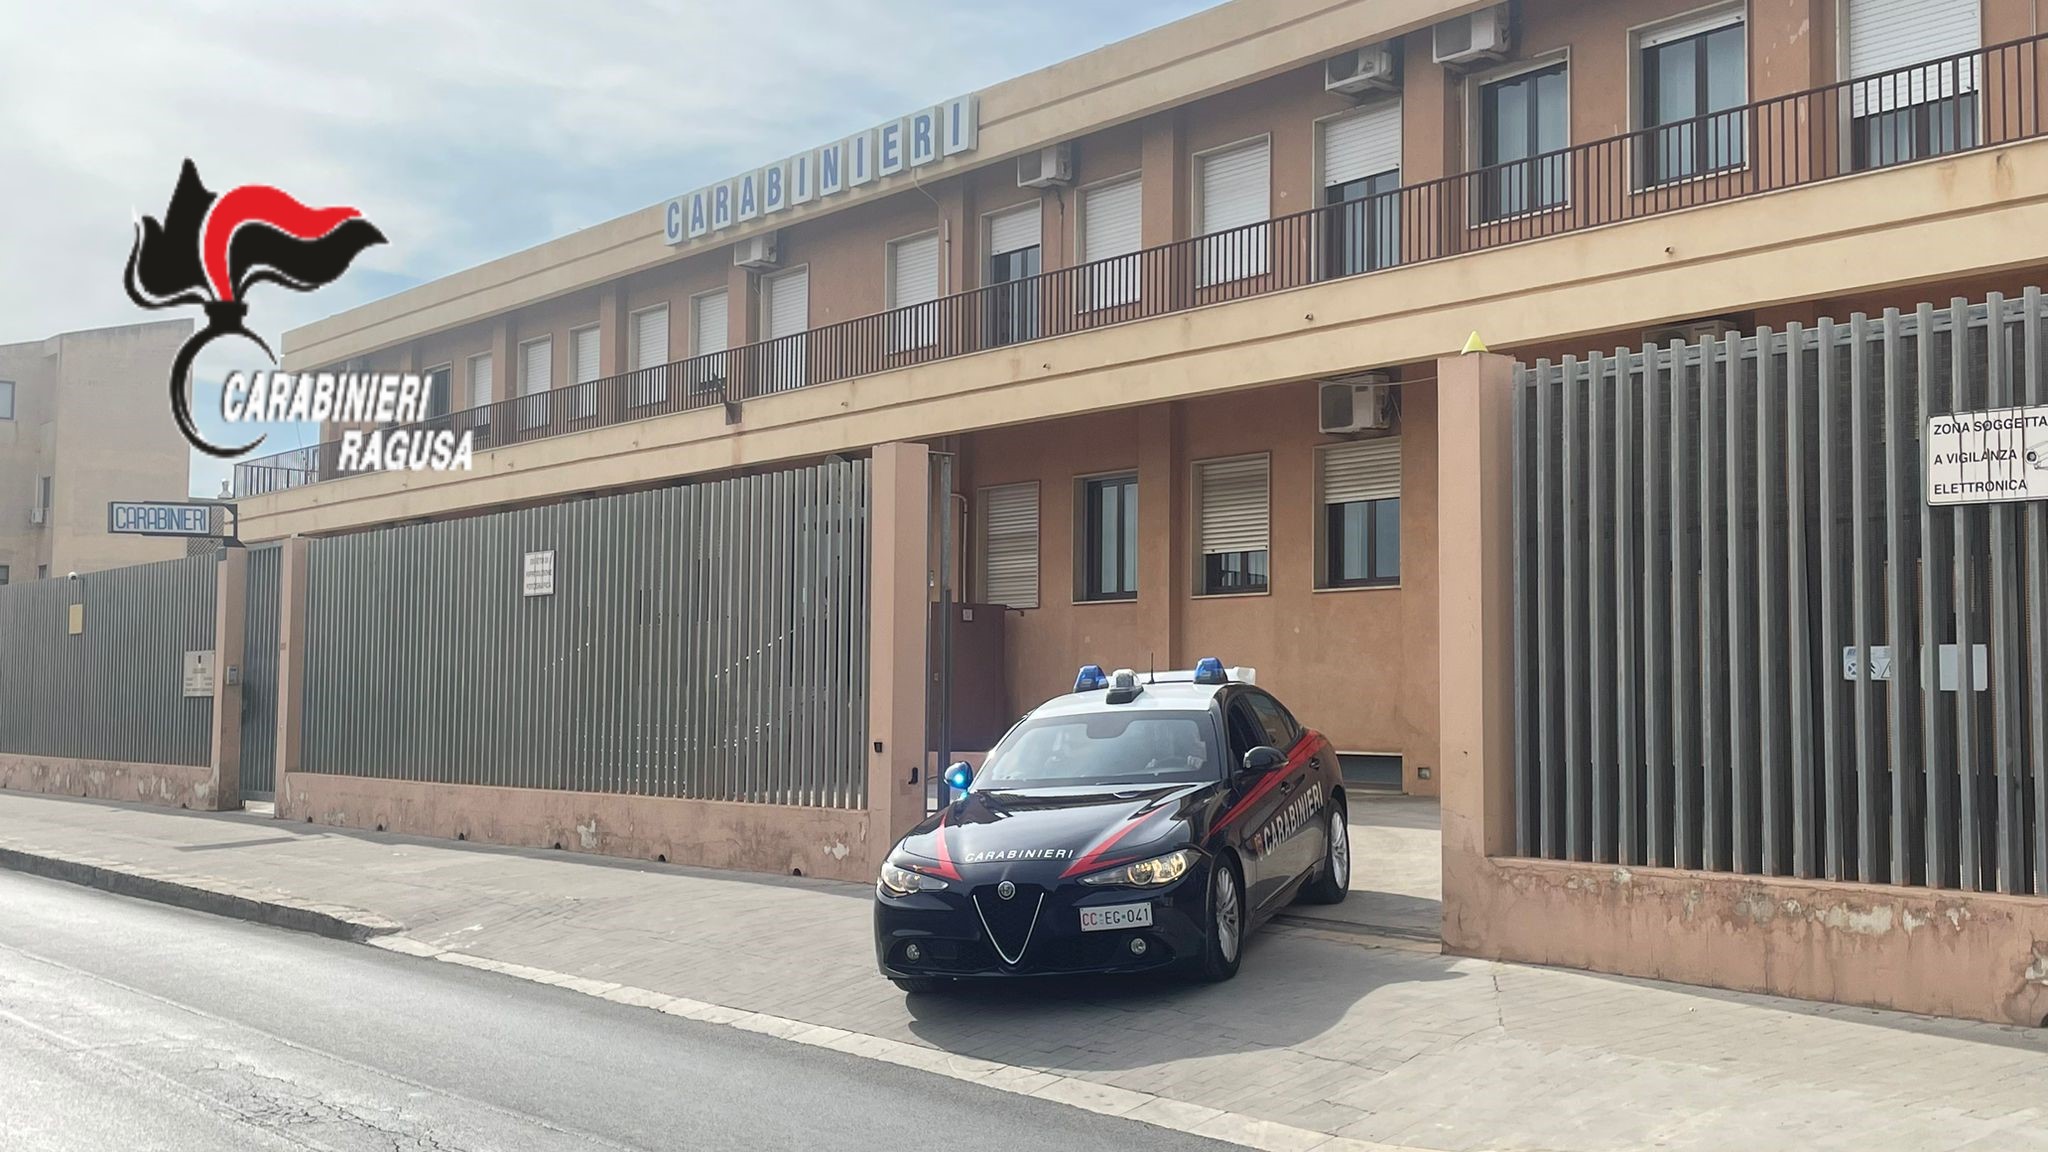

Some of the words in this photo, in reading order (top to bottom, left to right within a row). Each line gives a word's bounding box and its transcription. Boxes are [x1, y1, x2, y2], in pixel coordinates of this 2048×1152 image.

[667, 102, 960, 239] CARABINIERI
[1934, 422, 1970, 435] ZONA
[1974, 416, 2048, 432] SOGGETTA
[1934, 454, 1943, 465] A
[1946, 449, 2018, 464] VIGILANZA
[1934, 480, 2028, 495] ELETTRONICA
[115, 506, 207, 533] CARABINIERI
[1263, 780, 1324, 856] CARABINIERI
[965, 849, 1074, 862] CARABINIERI
